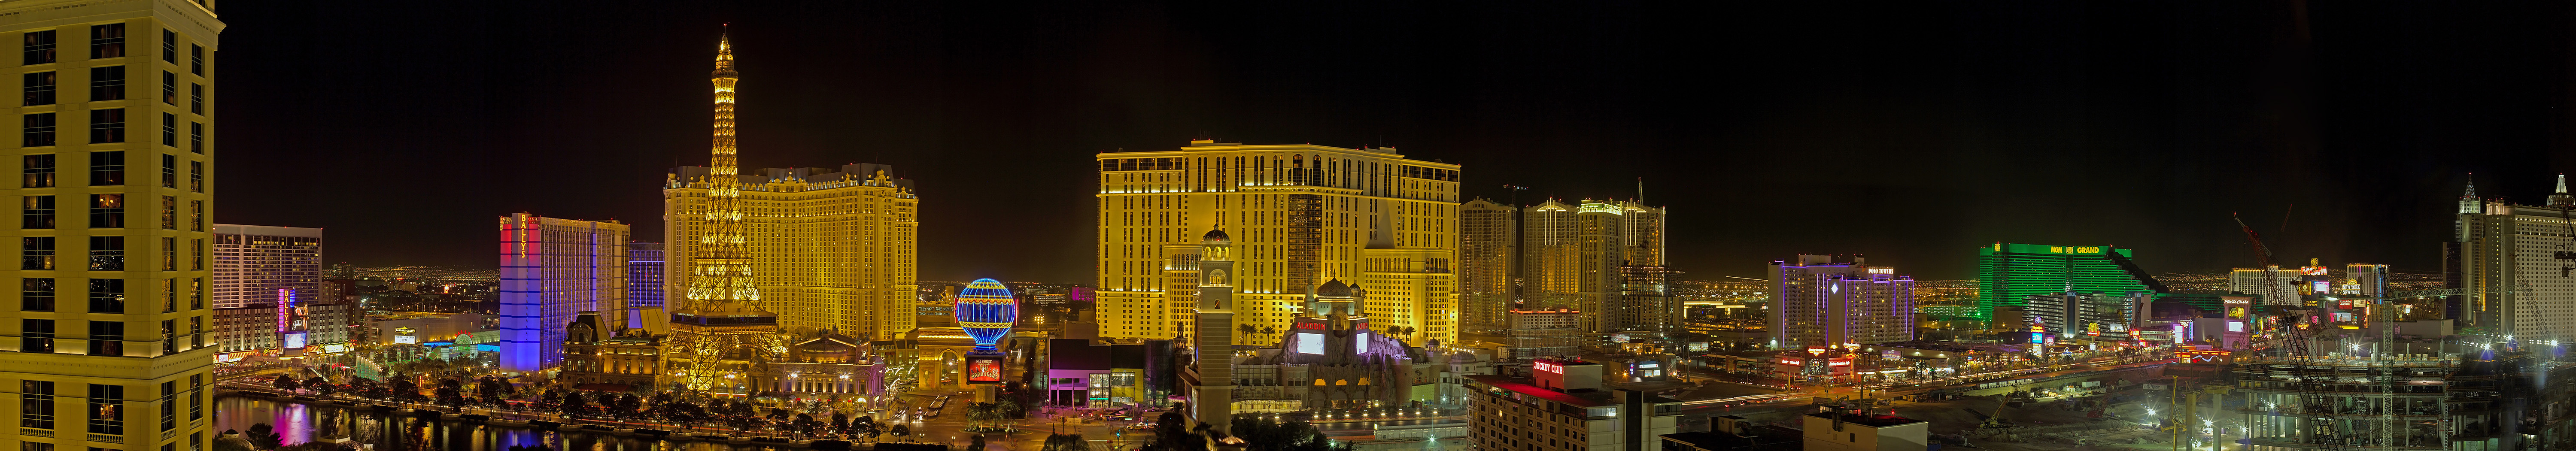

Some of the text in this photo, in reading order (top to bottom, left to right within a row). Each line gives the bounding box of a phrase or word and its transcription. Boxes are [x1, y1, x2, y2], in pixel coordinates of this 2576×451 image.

[2301, 266, 2327, 275] MGM
[1297, 322, 1326, 330] ALADDIN
[1356, 322, 1368, 330] ALADDIN
[1534, 362, 1563, 375] JOCKEY CLUB
